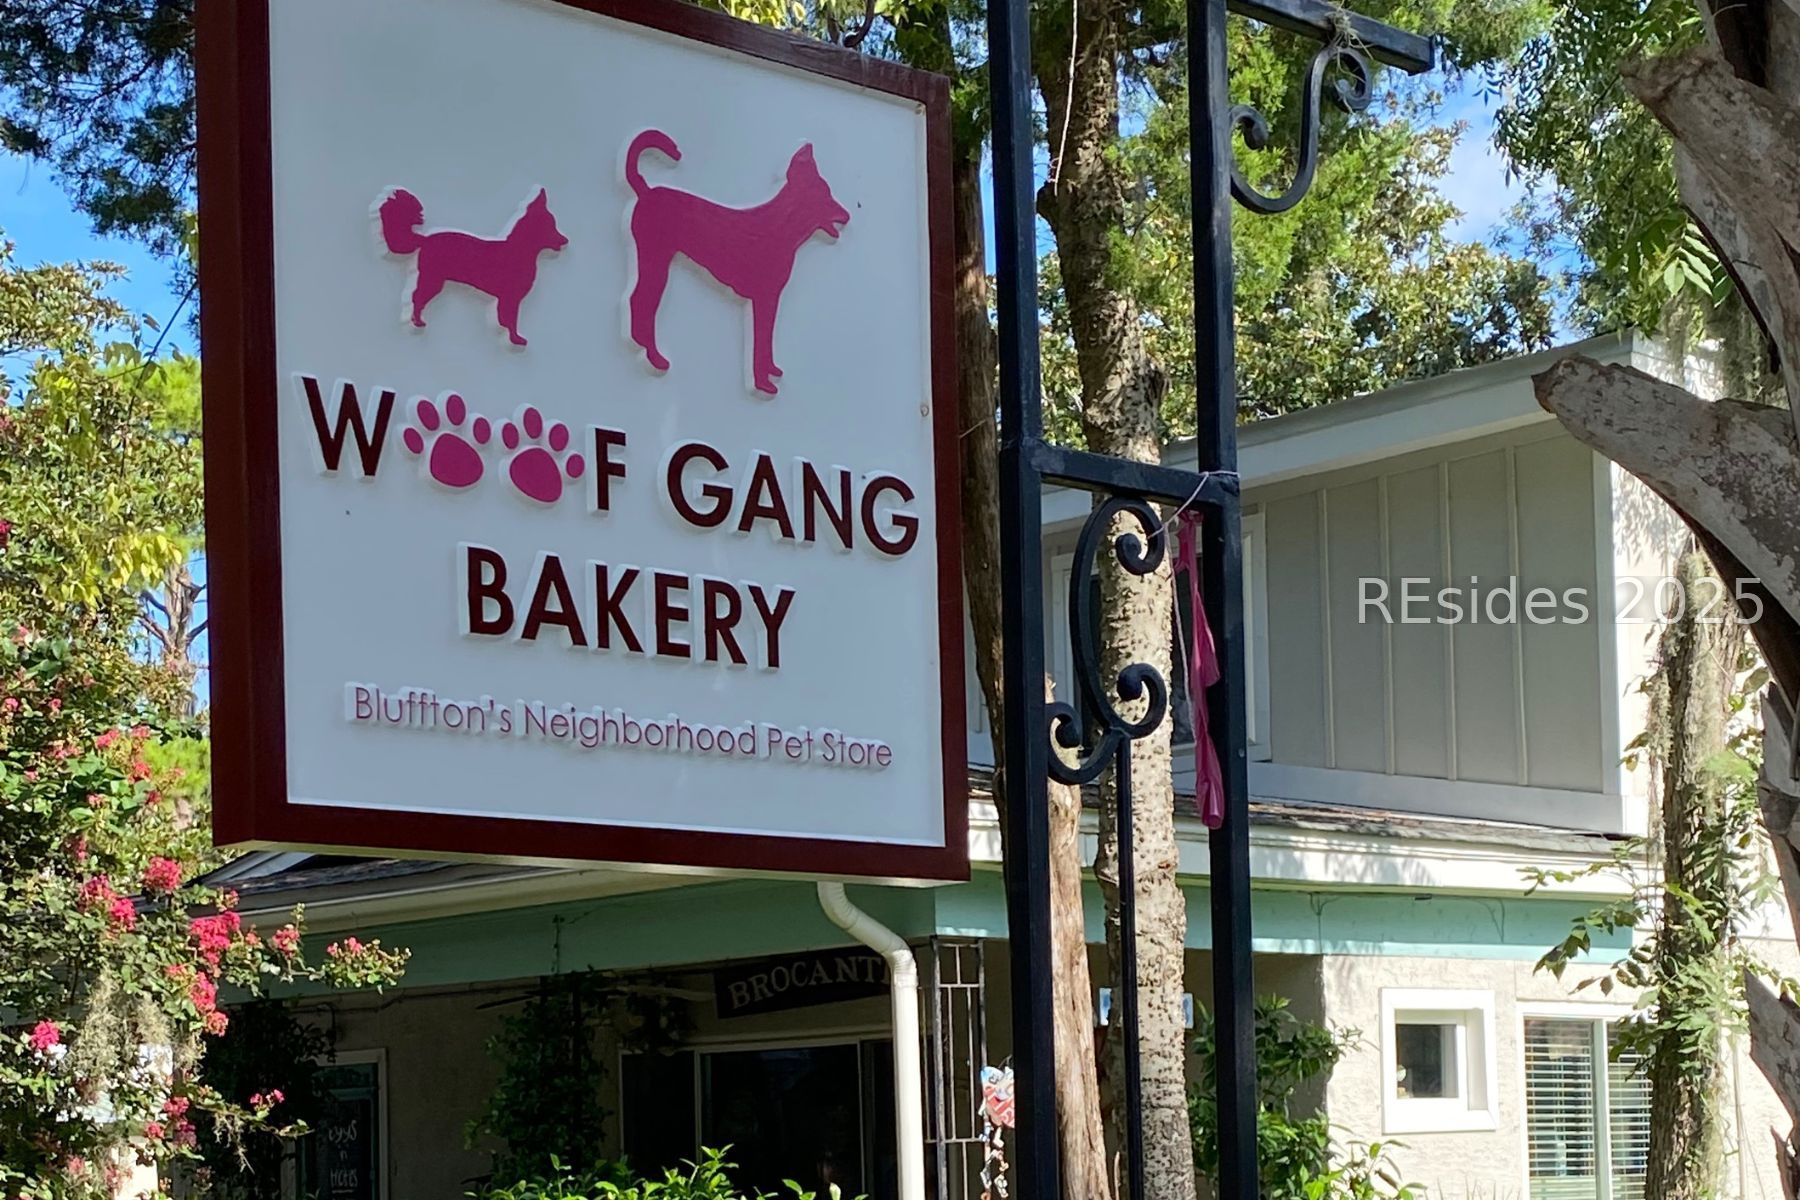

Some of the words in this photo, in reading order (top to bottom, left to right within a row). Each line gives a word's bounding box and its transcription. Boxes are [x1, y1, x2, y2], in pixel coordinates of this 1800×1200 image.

[666, 442, 920, 557] GANG
[466, 546, 796, 668] BAKERY
[355, 686, 512, 733] Bluffton's
[524, 704, 756, 755] Neighborhood
[767, 727, 814, 760] Pet
[821, 731, 893, 767] Store
